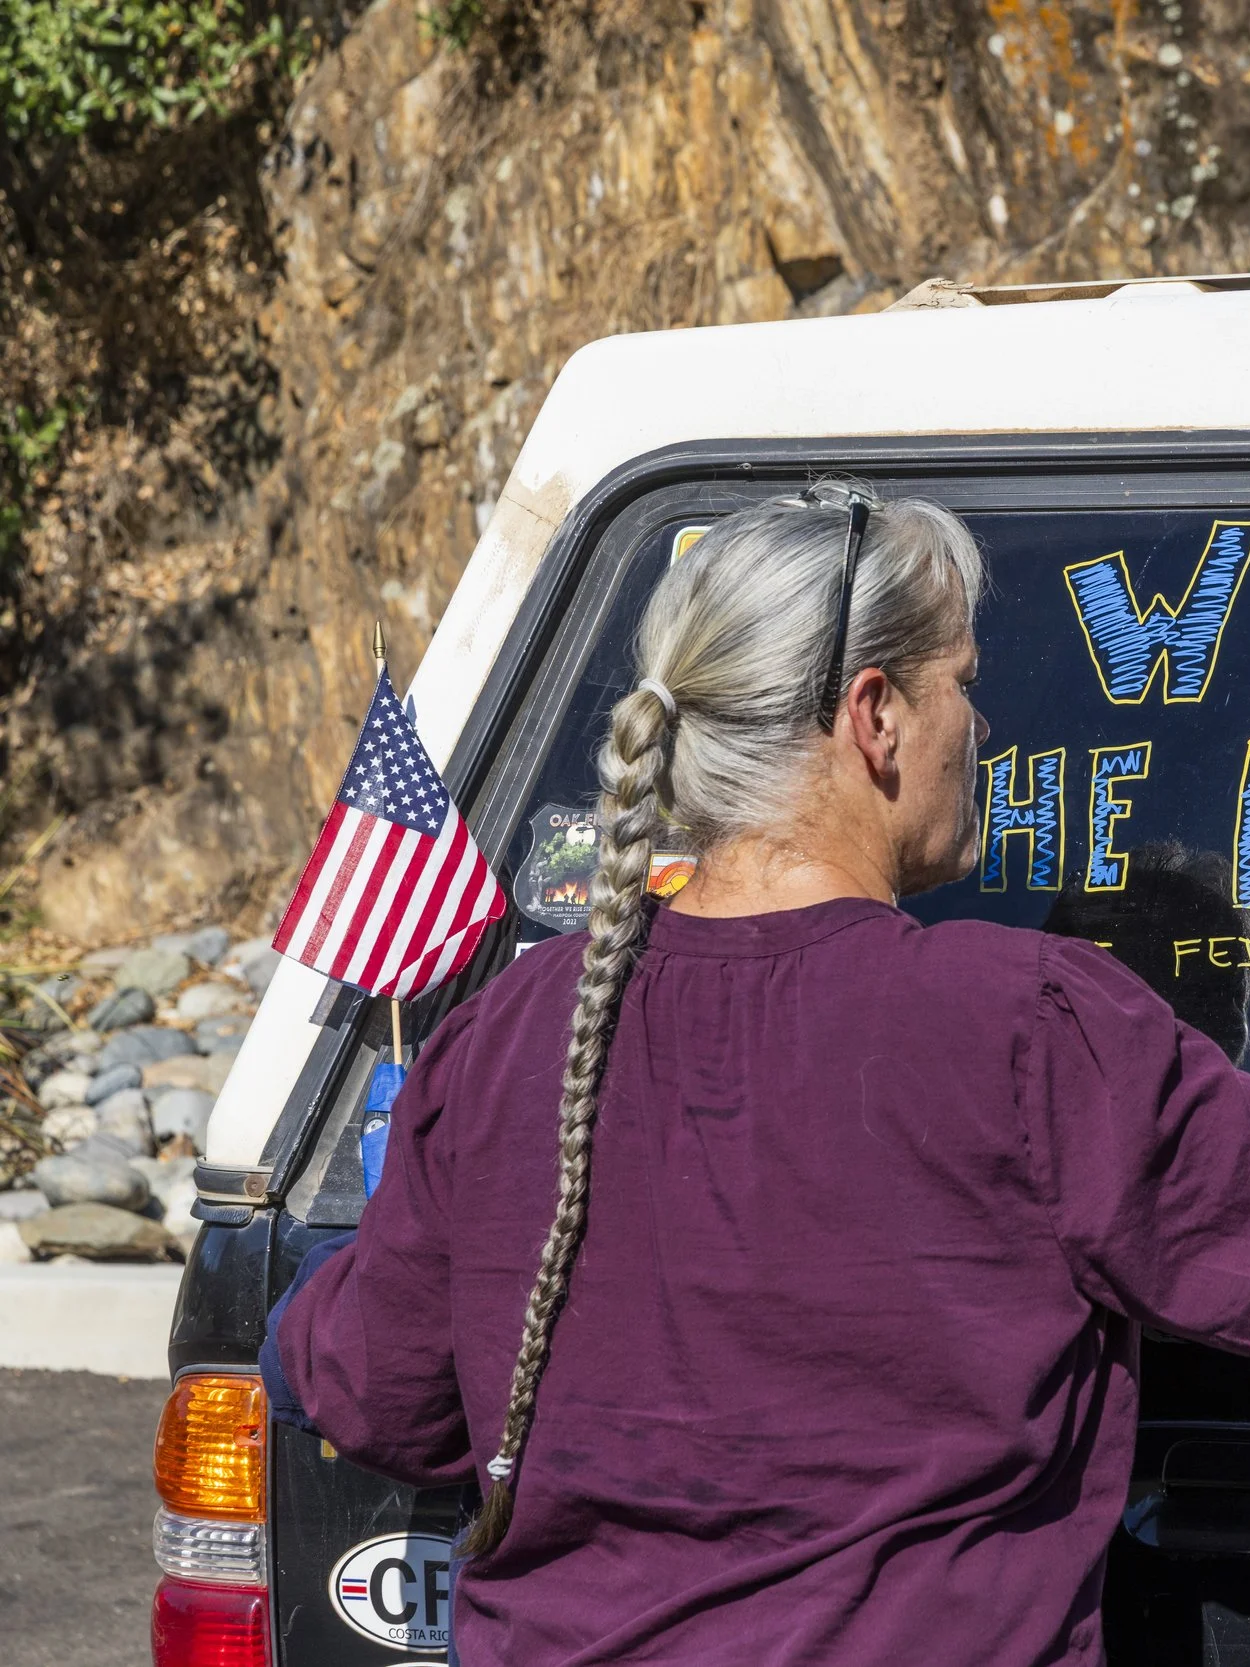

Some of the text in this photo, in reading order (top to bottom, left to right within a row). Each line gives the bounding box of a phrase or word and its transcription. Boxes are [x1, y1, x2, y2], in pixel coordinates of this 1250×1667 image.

[549, 813, 580, 827] OAK
[979, 741, 1153, 893] HE
[389, 1627, 448, 1641] COSTA RIC
